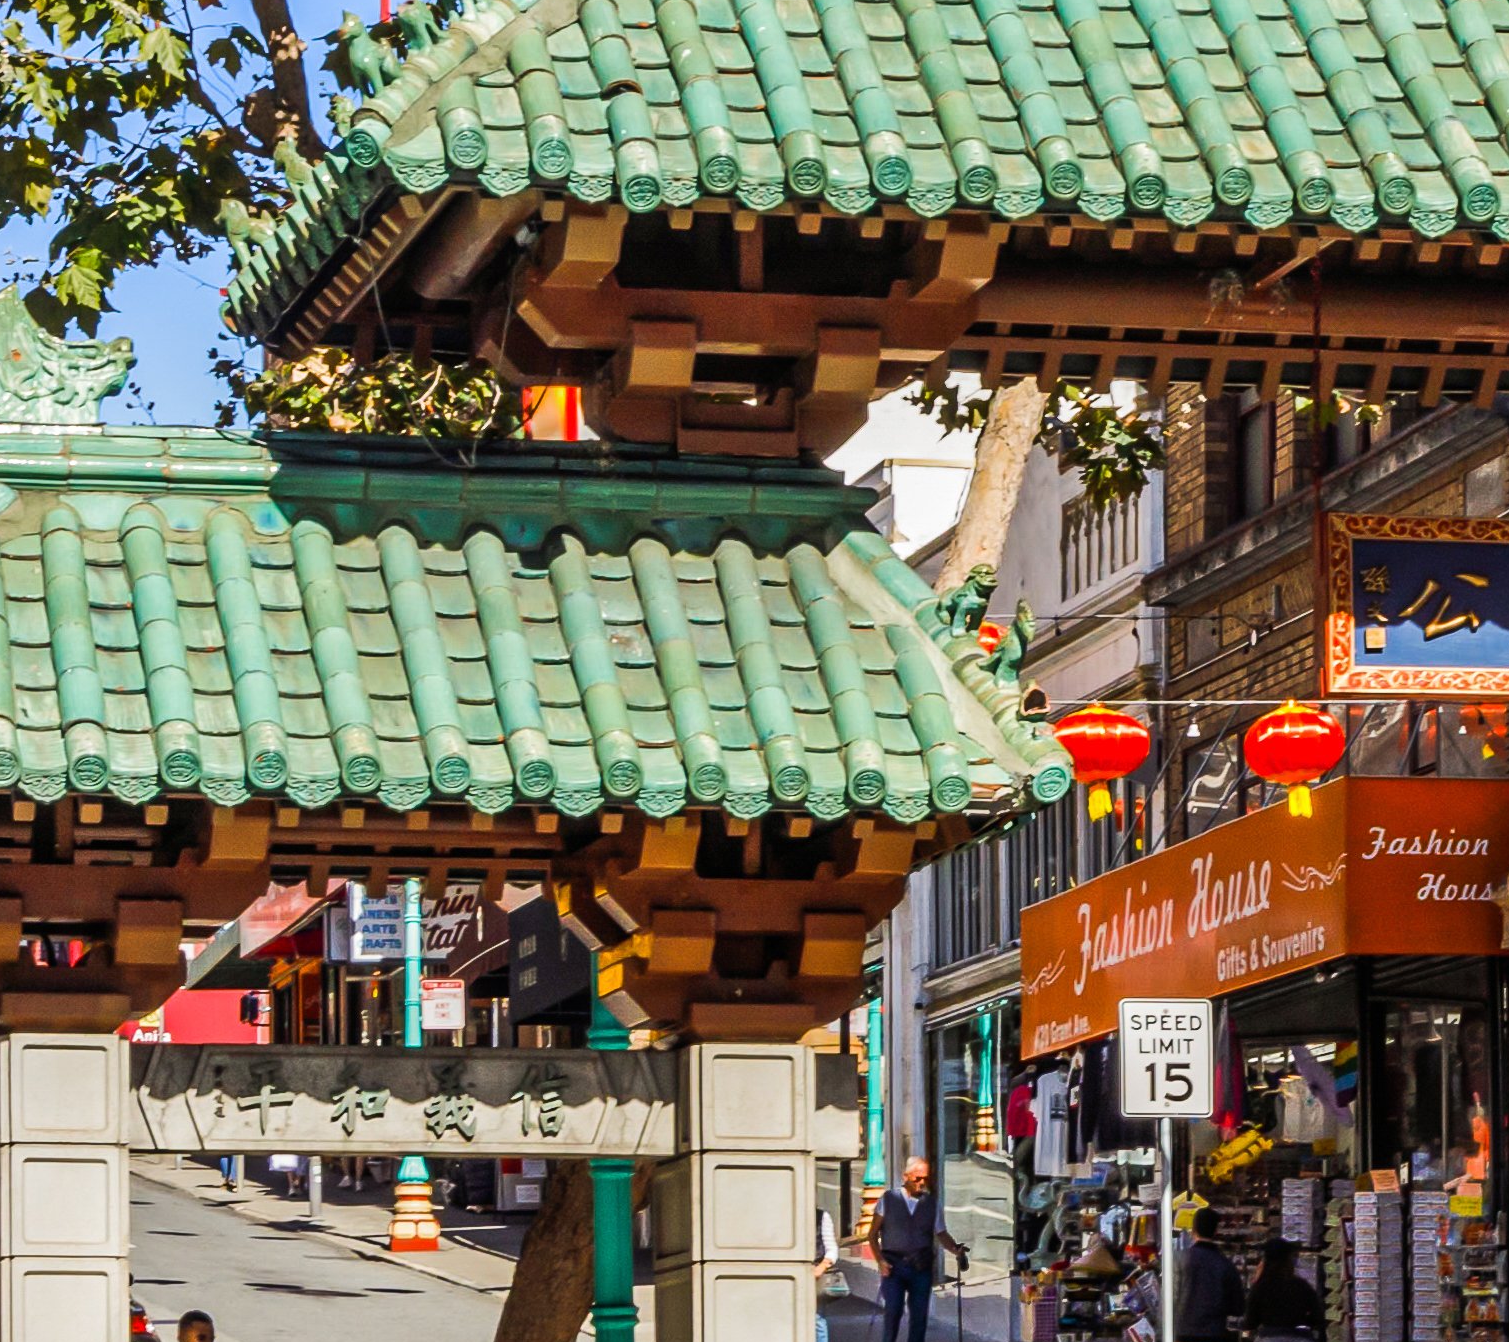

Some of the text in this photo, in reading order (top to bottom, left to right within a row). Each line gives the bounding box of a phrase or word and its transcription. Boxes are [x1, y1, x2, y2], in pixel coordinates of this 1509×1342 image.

[1361, 826, 1489, 860] Fashion
[1417, 872, 1492, 901] Hous
[1073, 852, 1271, 996] Fashion House
[1217, 921, 1326, 982] Gifts & Souvenirs
[132, 1028, 172, 1043] Ania
[1130, 1014, 1203, 1031] SPEED
[1139, 1038, 1195, 1054] LIMIT
[1145, 1062, 1194, 1103] 15
